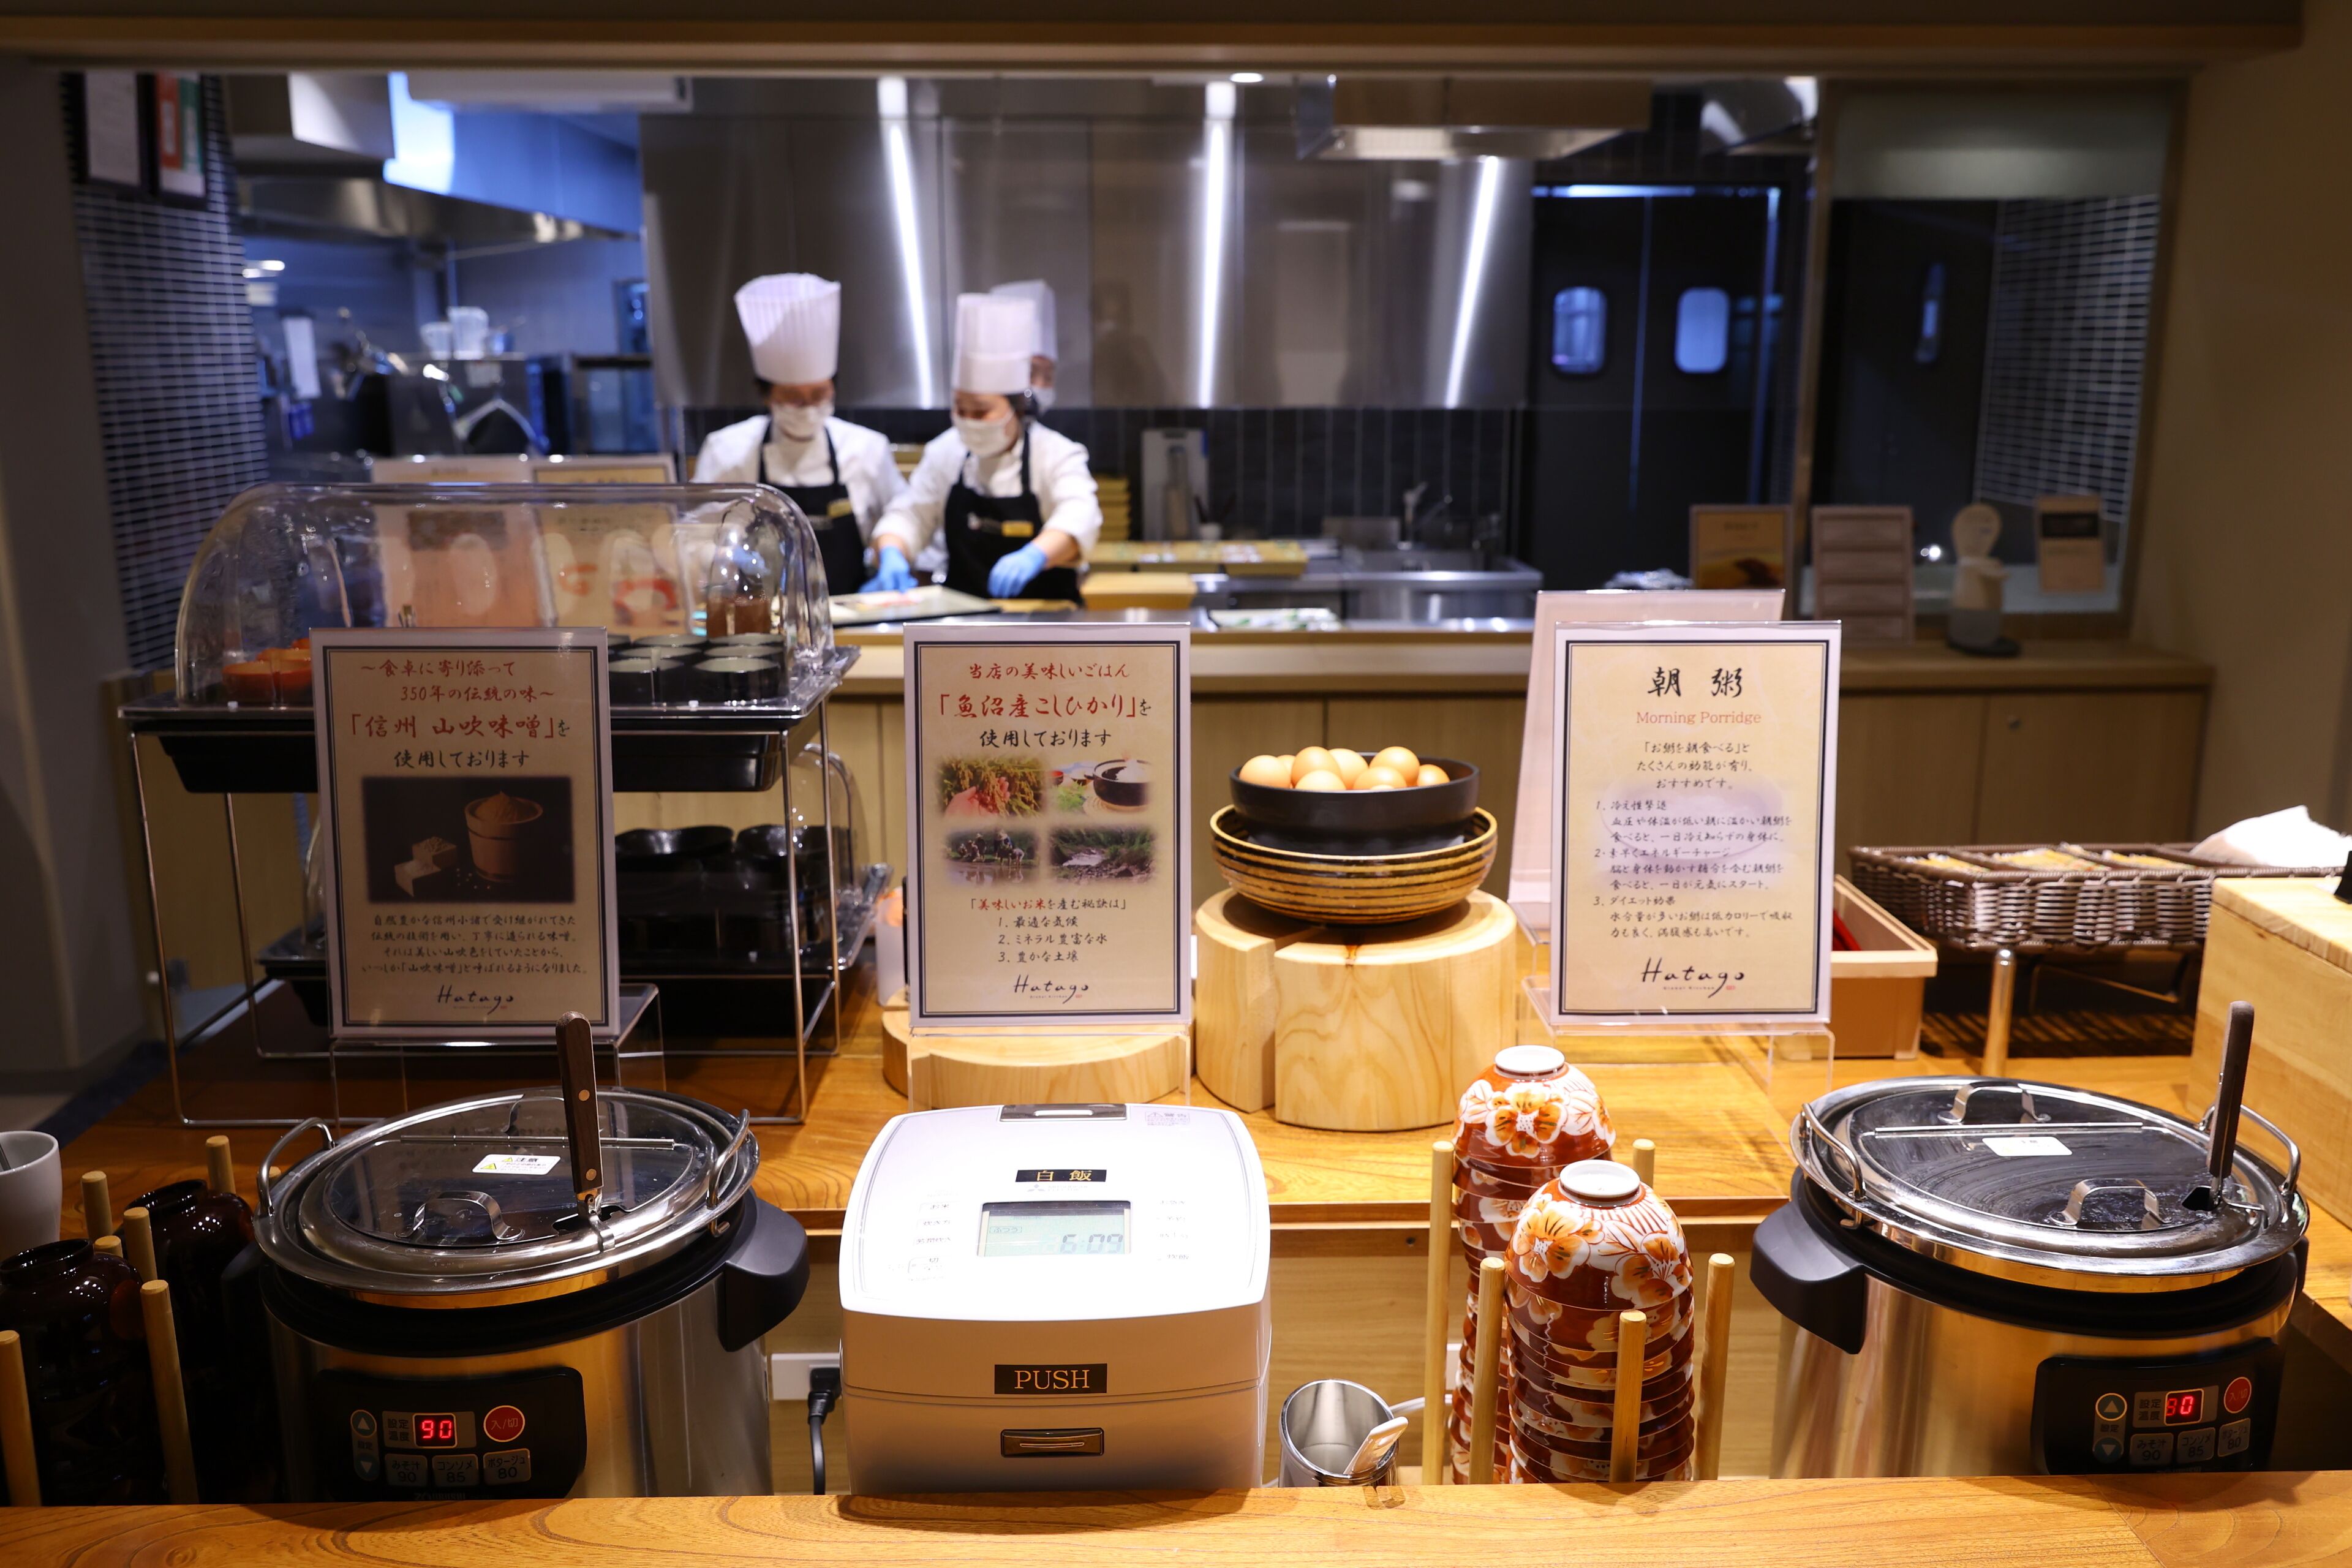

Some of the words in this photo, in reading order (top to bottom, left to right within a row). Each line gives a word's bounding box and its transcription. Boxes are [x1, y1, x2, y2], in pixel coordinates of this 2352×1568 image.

[970, 662, 1129, 680] 当店の美味しいごはん
[1648, 667, 1681, 697] 朝
[1712, 668, 1742, 698] 粥
[940, 693, 1152, 718] 「魚沼産こしひかり」を
[1637, 712, 1696, 725] Morning
[1700, 711, 1762, 725] Porridge
[980, 729, 1110, 748] 使用しております
[394, 750, 529, 769] 使用しております
[1014, 916, 1077, 928] 最適な気候
[998, 935, 1009, 944] 2.
[998, 952, 1009, 962] 3.
[1642, 958, 1744, 998] Hatago
[1014, 974, 1088, 1003] Hatago
[437, 985, 513, 1014] Hatago
[1036, 1170, 1054, 1181] 白
[1069, 1169, 1092, 1181] 飯
[1060, 1234, 1123, 1254] 6:09
[1014, 1370, 1090, 1389] PUSH
[421, 1420, 452, 1439] 90
[491, 1418, 519, 1430] 入/切
[2142, 1450, 2161, 1460] 90
[2188, 1446, 2204, 1458] 85
[437, 1461, 473, 1471] コンソメ
[498, 1467, 518, 1479] 80
[398, 1471, 417, 1482] 90
[447, 1471, 466, 1482] 85
